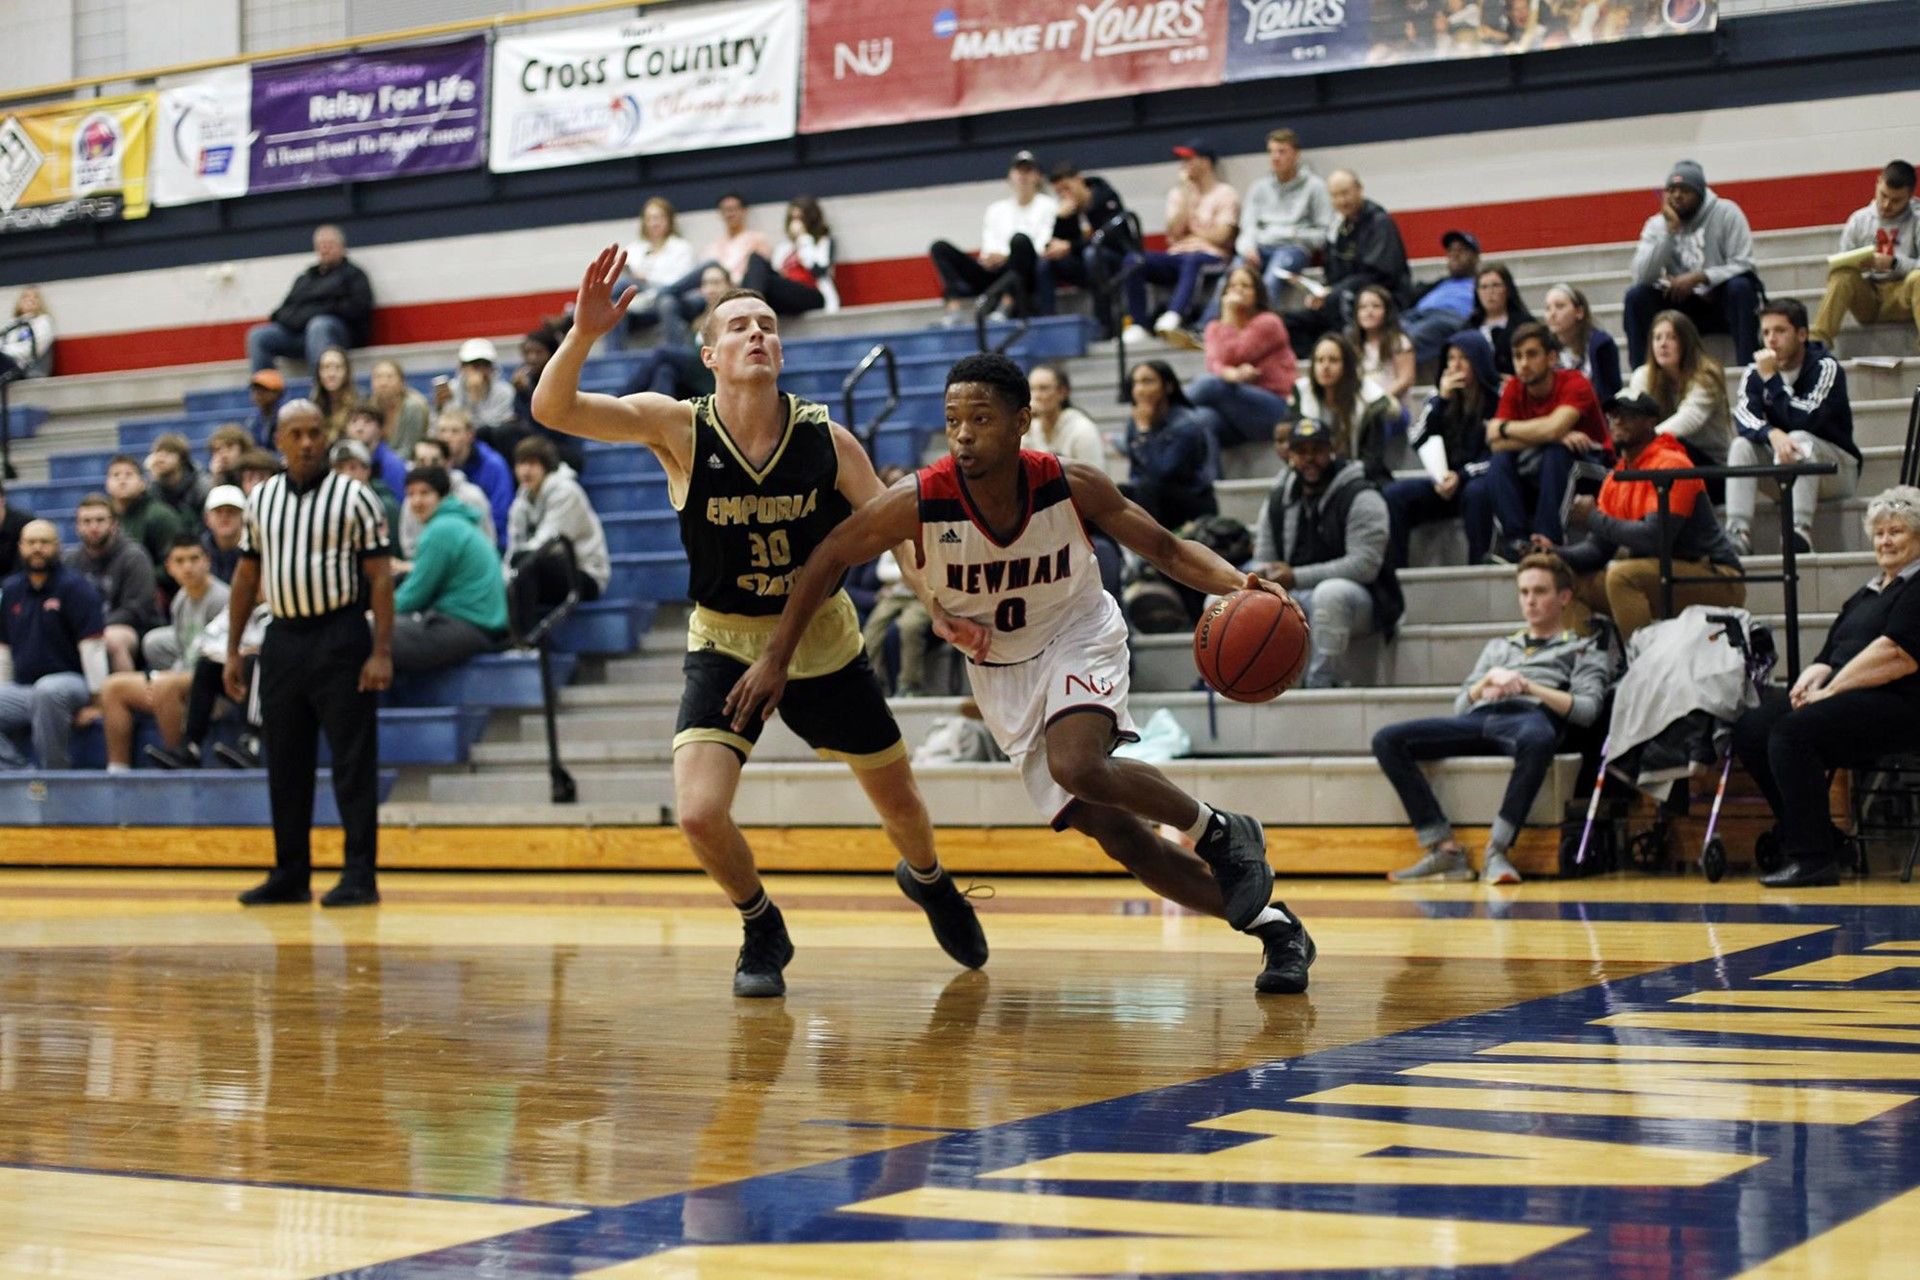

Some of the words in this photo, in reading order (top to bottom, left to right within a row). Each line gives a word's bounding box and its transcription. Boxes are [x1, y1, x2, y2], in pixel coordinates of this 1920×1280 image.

[951, 24, 1041, 61] MAKE
[1043, 19, 1078, 51] IT
[1076, 0, 1204, 62] YOURS
[1241, 0, 1345, 45] YOURS
[521, 56, 608, 93] Cross
[623, 33, 768, 79] Country
[834, 37, 893, 80] NU
[308, 89, 376, 123] Relay
[378, 84, 423, 114] For
[425, 73, 476, 108] Life
[706, 488, 818, 526] EMPORIA
[749, 529, 791, 568] 30
[946, 543, 1071, 595] NEWMAN
[995, 597, 1026, 632] 0
[1065, 674, 1114, 696] NU
